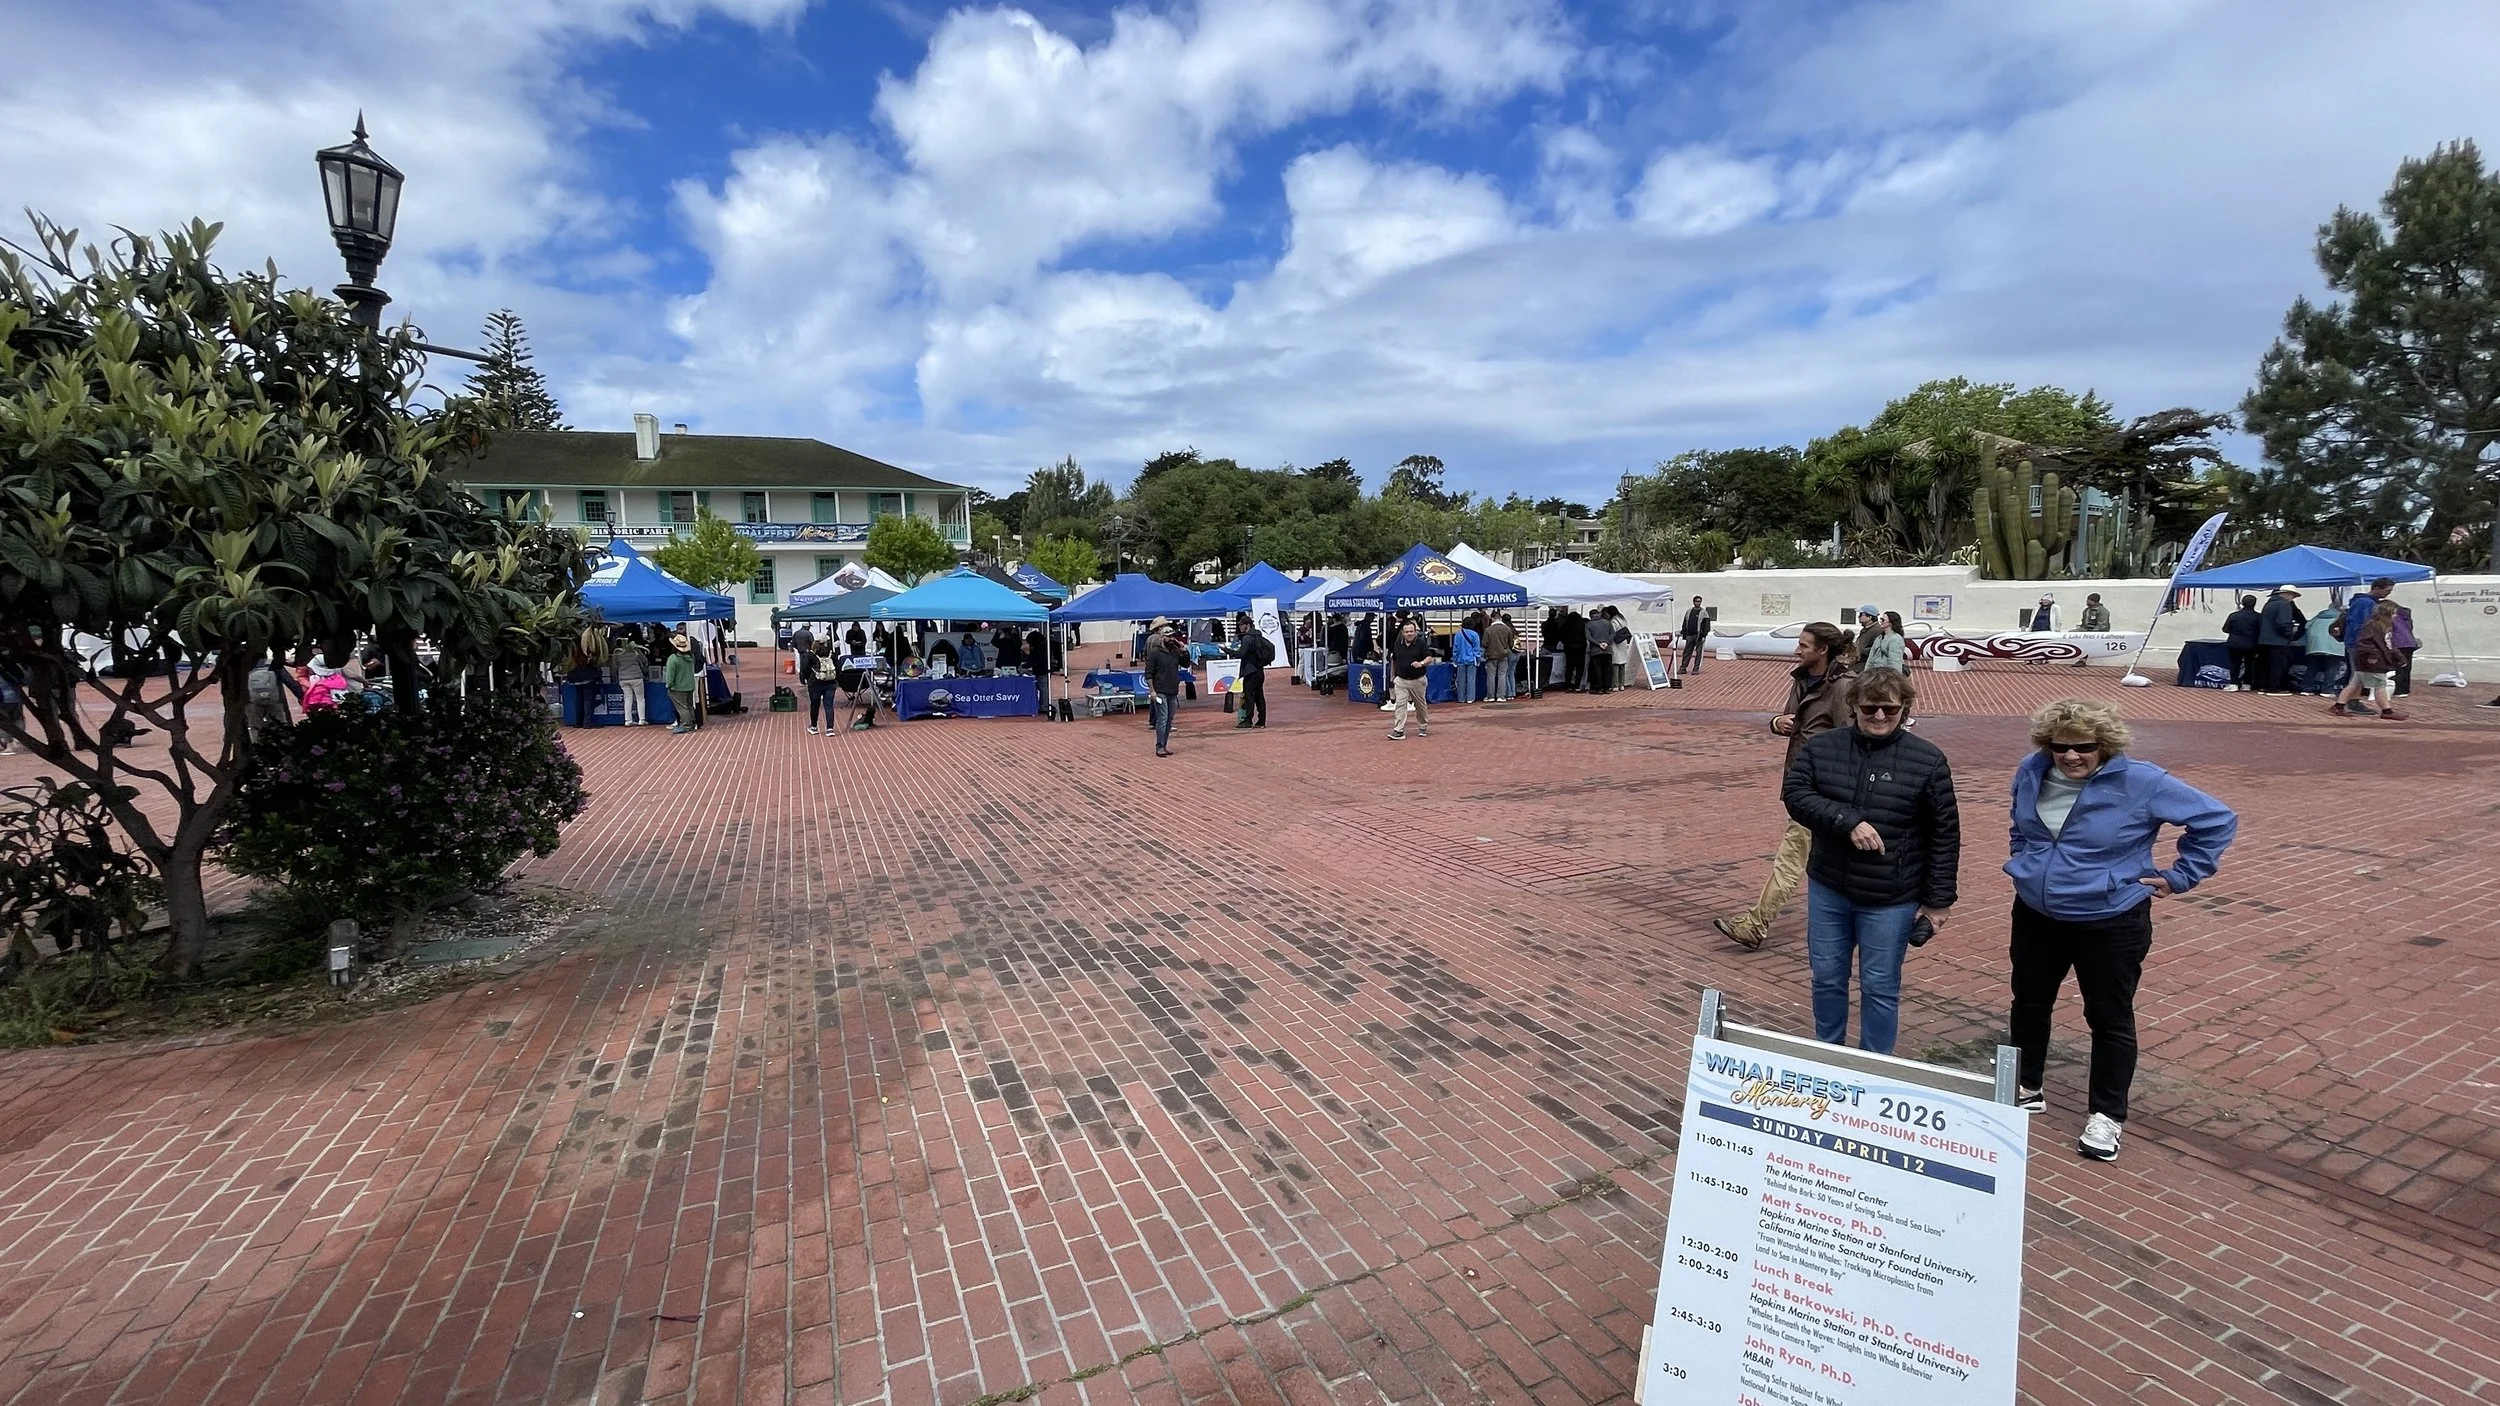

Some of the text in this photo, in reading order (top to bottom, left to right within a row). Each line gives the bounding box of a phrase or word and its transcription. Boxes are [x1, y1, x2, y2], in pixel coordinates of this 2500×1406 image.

[734, 528, 796, 538] WHALEFEST
[1328, 598, 1380, 608] CALIFORNIA STATE PARKS
[1396, 593, 1518, 608] CALIFORNIA STATE PARKS
[2105, 642, 2127, 650] 126
[955, 692, 1020, 703] Sea Otter Savvy
[1705, 1052, 1946, 1131] WHALEFEST 2026
[1730, 1078, 1831, 1120] Monterey
[1696, 1132, 1754, 1156] 11:00-11:45
[1752, 1117, 1925, 1173] SUNDAY APRIL 12
[1832, 1112, 1998, 1164] SYMPOSIUM SCHEDULE
[1690, 1172, 1748, 1196] 11:45-12:30
[1766, 1152, 1852, 1183] Adam Ratner
[1765, 1165, 1888, 1207] The Marine Mammal Center
[1762, 1192, 1886, 1240] Matt Savoca, Ph.D.
[1764, 1177, 1787, 1190] "Behind
[1788, 1182, 1797, 1194] the
[1799, 1188, 1815, 1200] Bark:
[1817, 1192, 1825, 1202] 50
[1828, 1195, 1844, 1208] Years
[1846, 1202, 1852, 1210] of
[1854, 1204, 1875, 1219] Saving
[1877, 1210, 1894, 1223] Seals
[1896, 1218, 1908, 1227] and
[1910, 1220, 1922, 1231] Sea
[1681, 1236, 1738, 1262] 12:30-2:00
[1755, 1243, 1770, 1255] Land
[1779, 1251, 1790, 1262] Sea
[1791, 1256, 1798, 1264] in
[1798, 1257, 1828, 1276] Monterey
[1758, 1219, 1944, 1286] California Marine Sanctuary Foundation
[1760, 1206, 1978, 1284] Hopkins Marine Station at Stanford University,
[1678, 1254, 1729, 1280] 2:00-2:45
[1754, 1260, 1834, 1296] Lunch Break
[1758, 1232, 1934, 1296] "From Watershed to Whales: Tracking Microplastics from
[1671, 1306, 1722, 1334] 2:45-3:30
[1746, 1316, 1762, 1330] from
[1763, 1323, 1780, 1337] Video
[1781, 1330, 1805, 1347] Camera
[1752, 1278, 1980, 1368] Jack Barkowski, Ph.D. Candidate
[1748, 1305, 1933, 1381] "Whales Beneath the Waves: Insights into Whale Behavior
[1750, 1292, 1970, 1382] Hopkins Marine Station at Stanford University
[1663, 1362, 1686, 1380] 3:30
[1743, 1349, 1774, 1368] MBARI
[1744, 1334, 1856, 1387] John Ryan, Ph.D.
[1738, 1393, 1764, 1406] Joh
[1740, 1376, 1766, 1393] National
[1766, 1386, 1789, 1403] Marine
[1742, 1363, 1770, 1383] "Creating
[1772, 1374, 1788, 1388] Safer
[1790, 1382, 1813, 1398] Habitat
[1814, 1391, 1824, 1403] for
